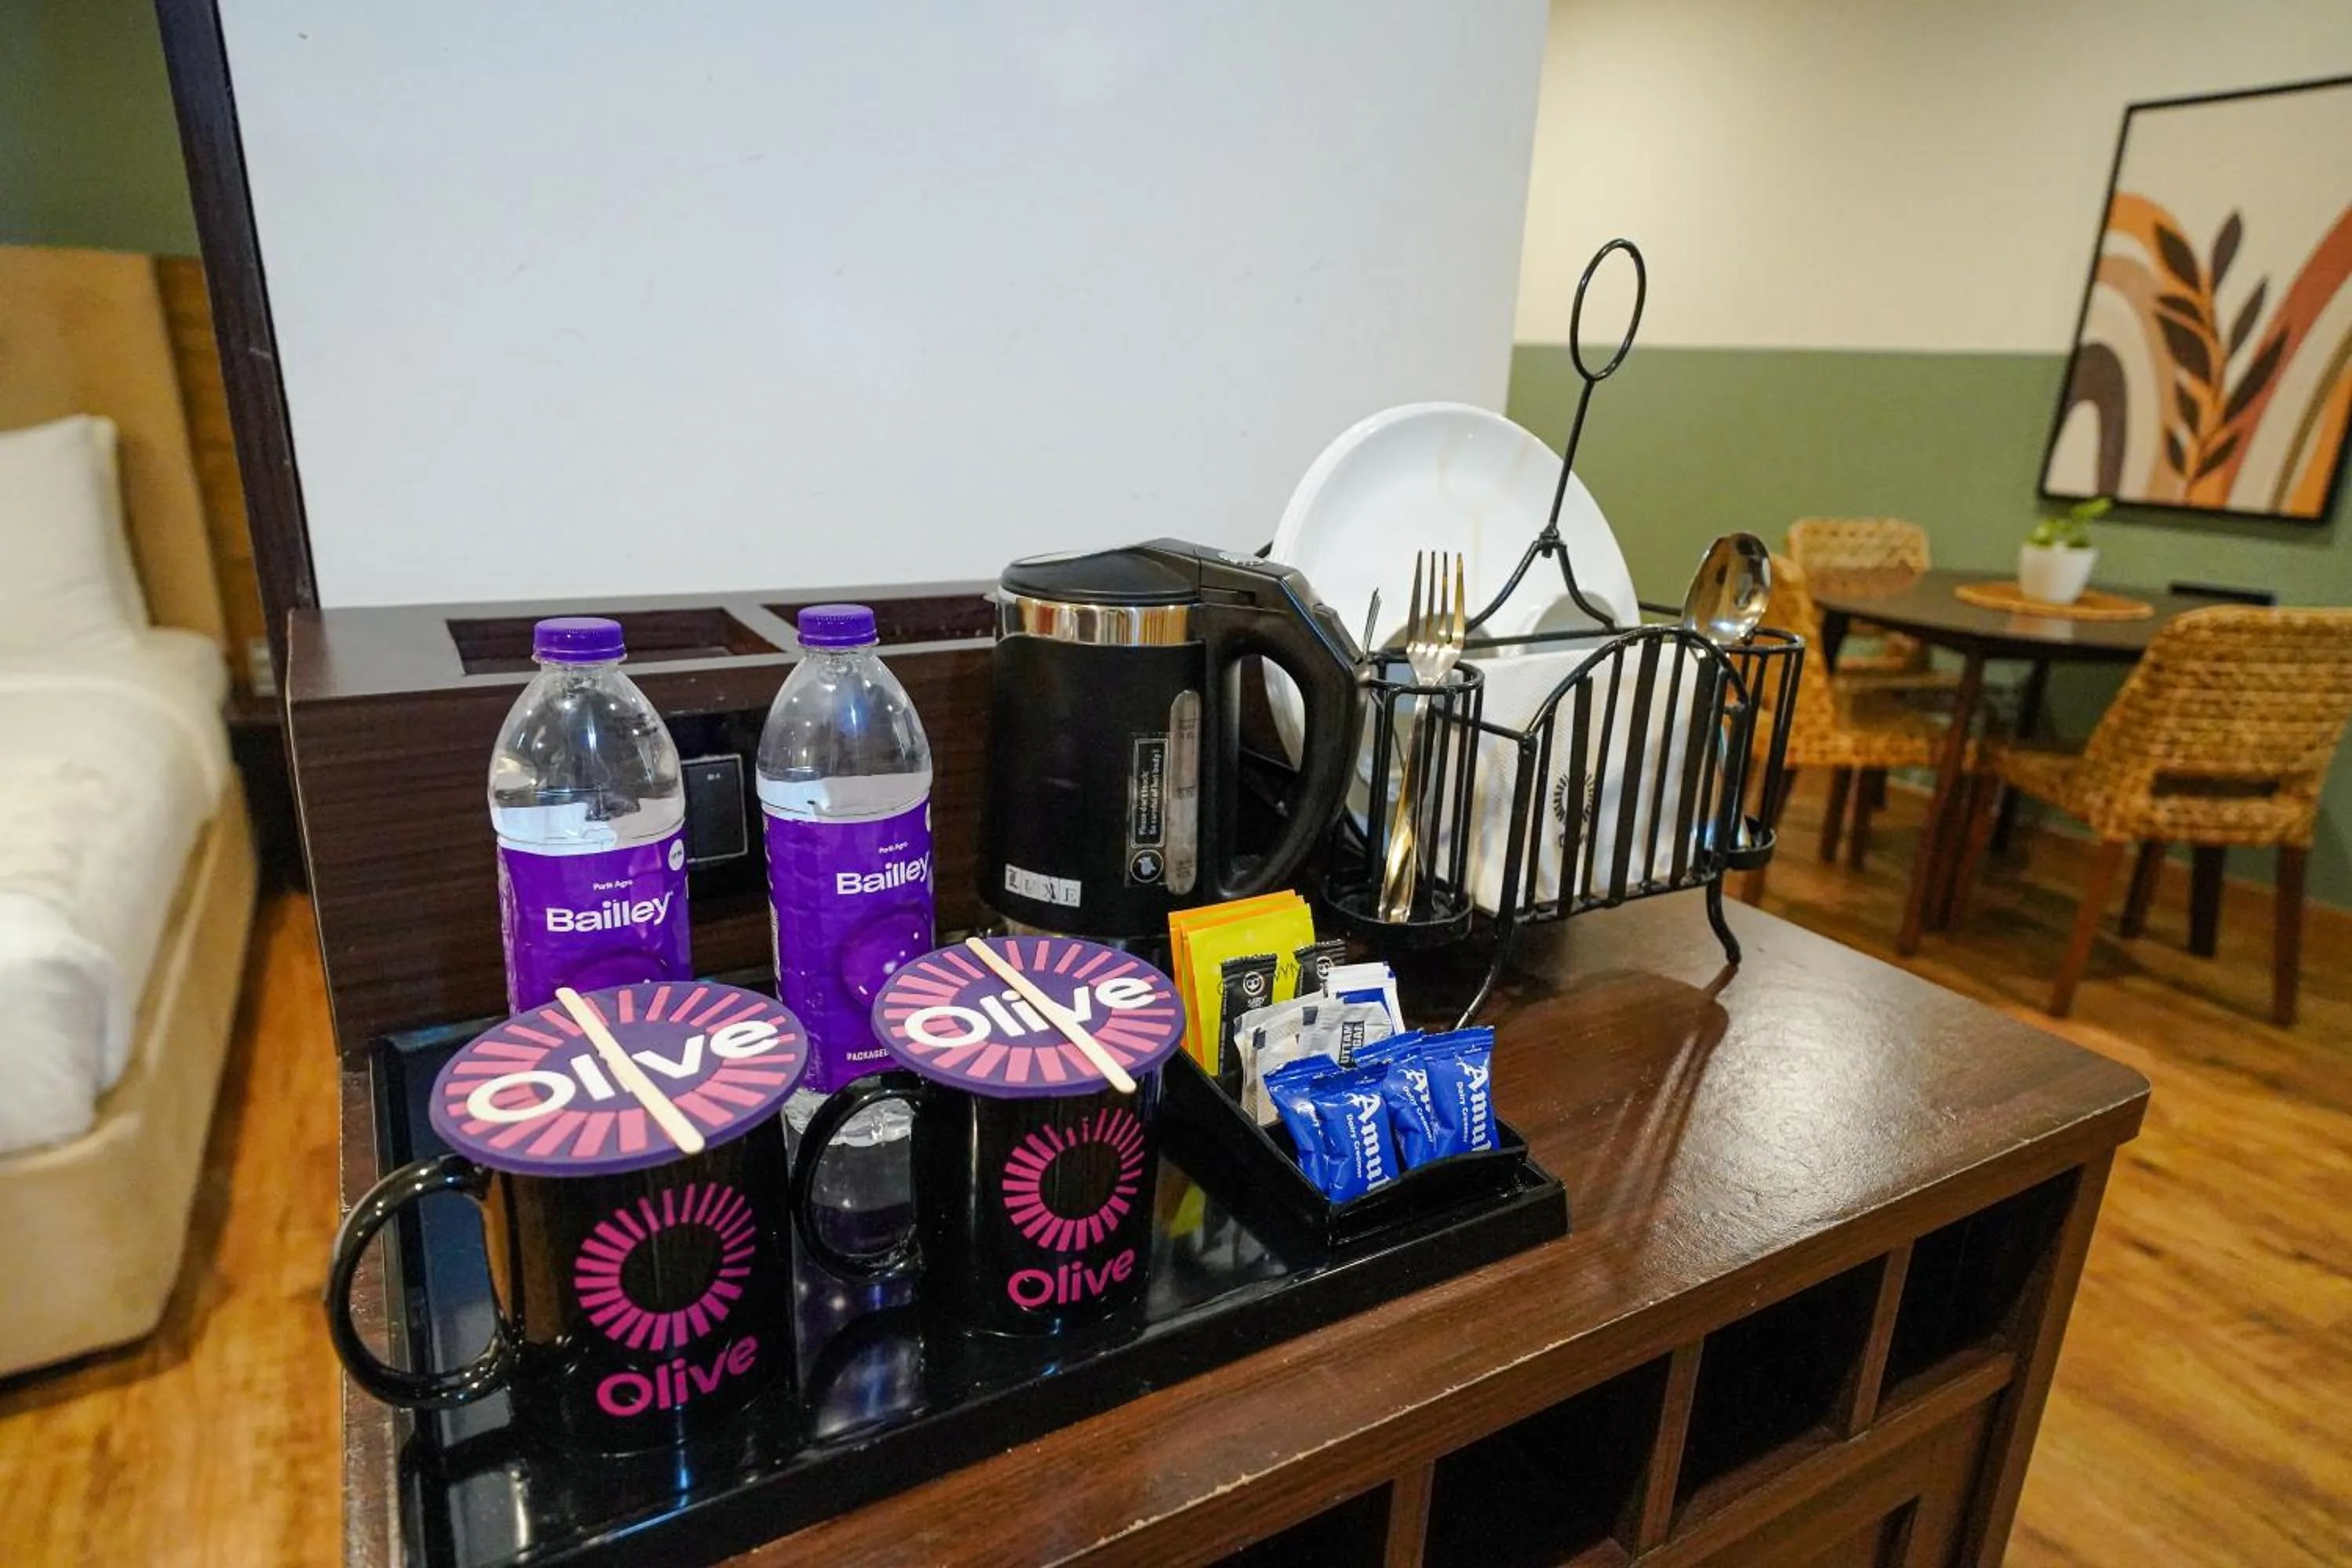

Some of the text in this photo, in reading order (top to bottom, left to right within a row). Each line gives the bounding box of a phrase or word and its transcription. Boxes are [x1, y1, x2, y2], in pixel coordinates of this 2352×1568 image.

[546, 891, 670, 932] Bailley
[837, 851, 930, 895] Bailley
[467, 1020, 779, 1123] Olve
[1457, 1062, 1492, 1151] Amul
[1343, 1093, 1392, 1191] Amul
[1007, 1249, 1135, 1307] Olive
[596, 1336, 759, 1417] Olive
